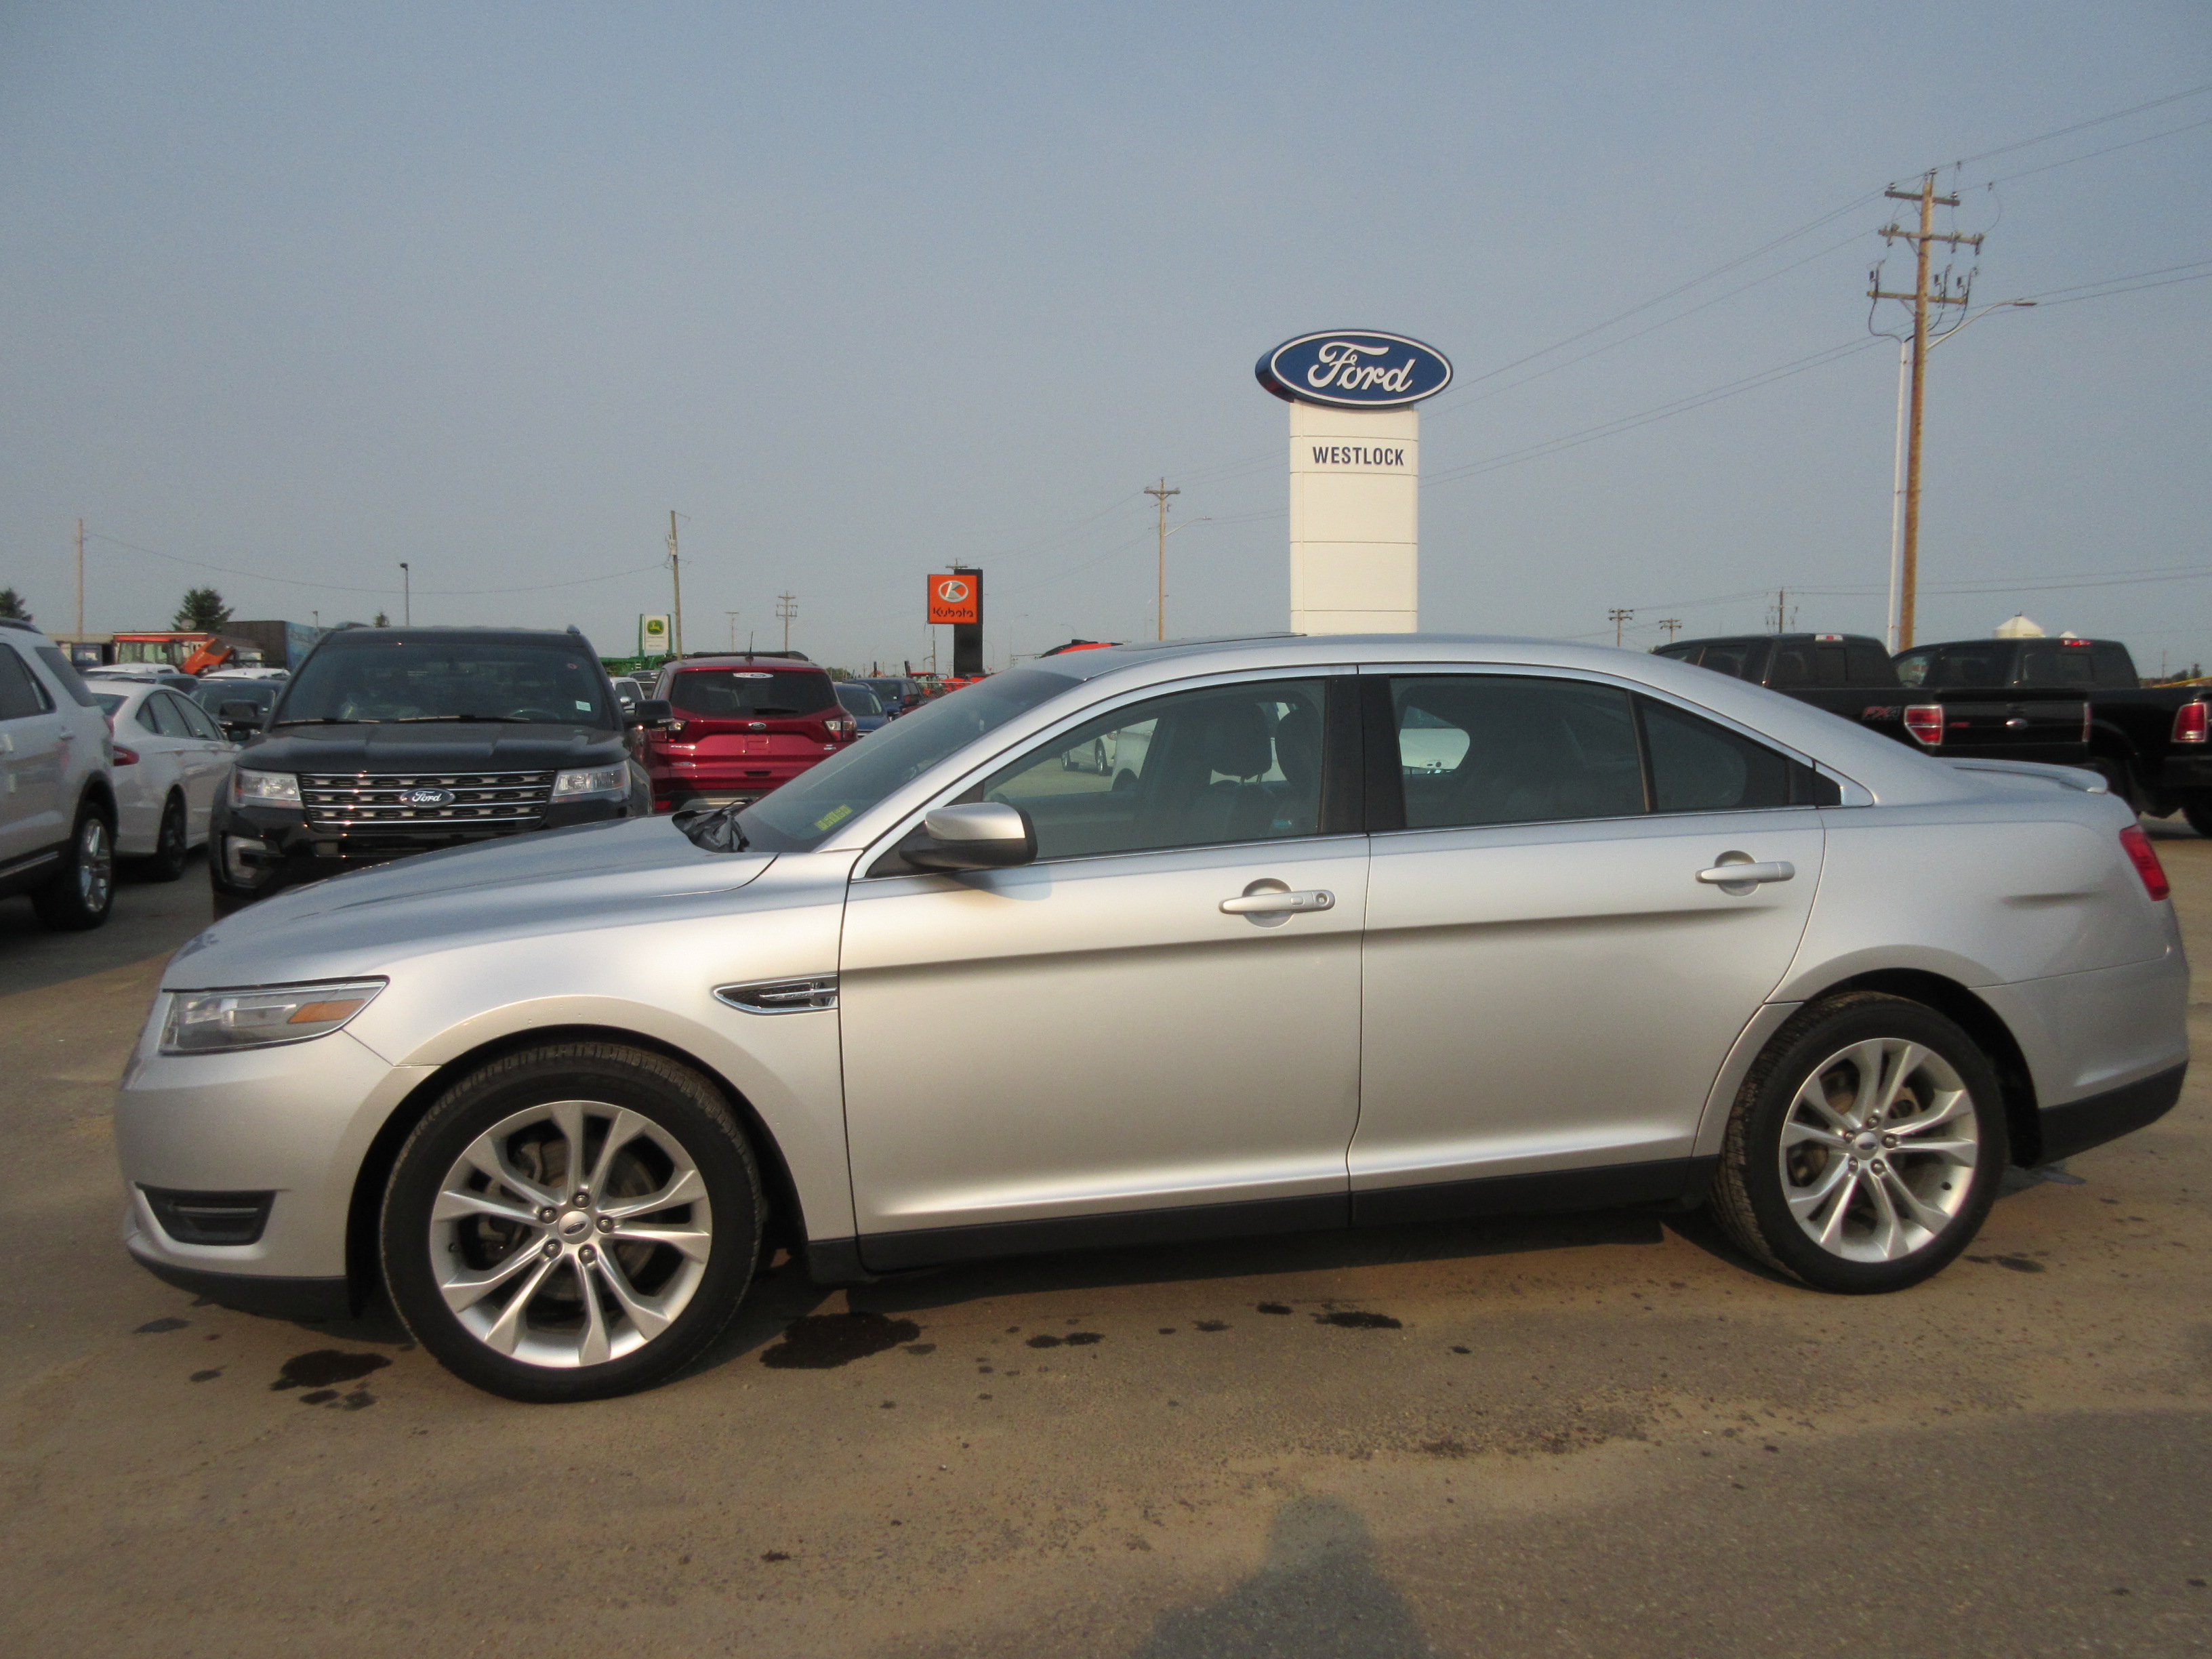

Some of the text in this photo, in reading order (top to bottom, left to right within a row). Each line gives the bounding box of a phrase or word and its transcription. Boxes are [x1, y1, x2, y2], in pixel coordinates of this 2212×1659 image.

[1307, 341, 1416, 392] Ford
[1313, 446, 1404, 466] WESTLOCK
[933, 607, 974, 617] Kubota
[411, 790, 443, 802] Ford
